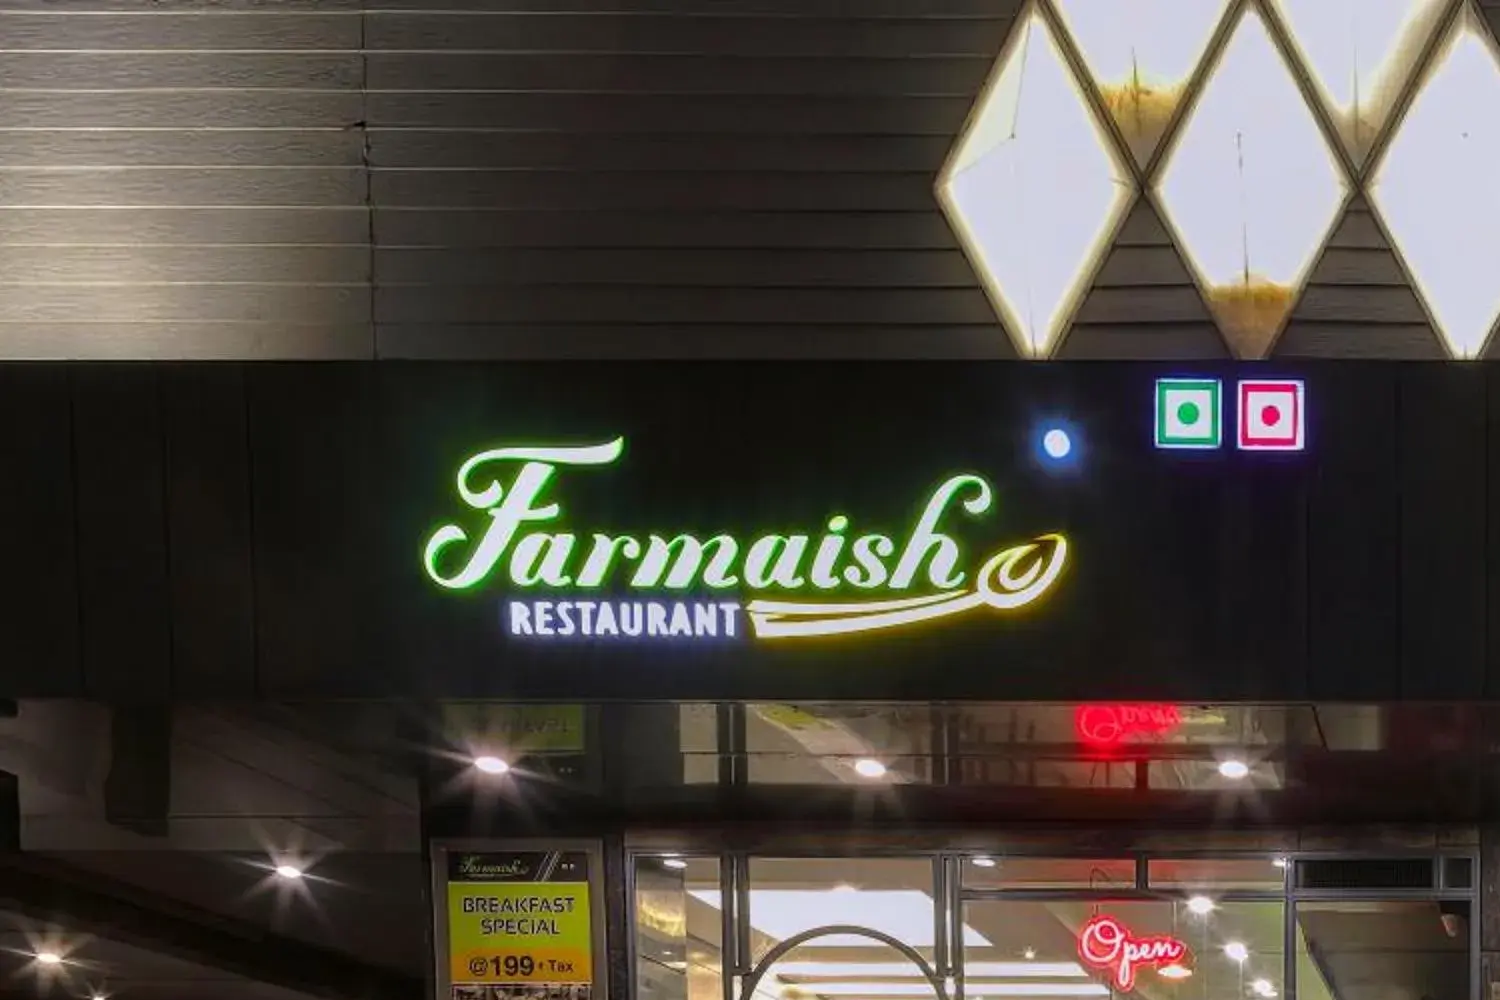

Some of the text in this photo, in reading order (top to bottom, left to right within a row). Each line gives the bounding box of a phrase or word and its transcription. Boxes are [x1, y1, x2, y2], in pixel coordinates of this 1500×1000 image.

[424, 434, 993, 590] Farmaish
[510, 601, 739, 637] RESTAURANT
[463, 897, 575, 913] BREAKFAST
[481, 919, 560, 935] SPECIAL
[548, 960, 574, 973] Tax
[1080, 919, 1183, 988] Open
